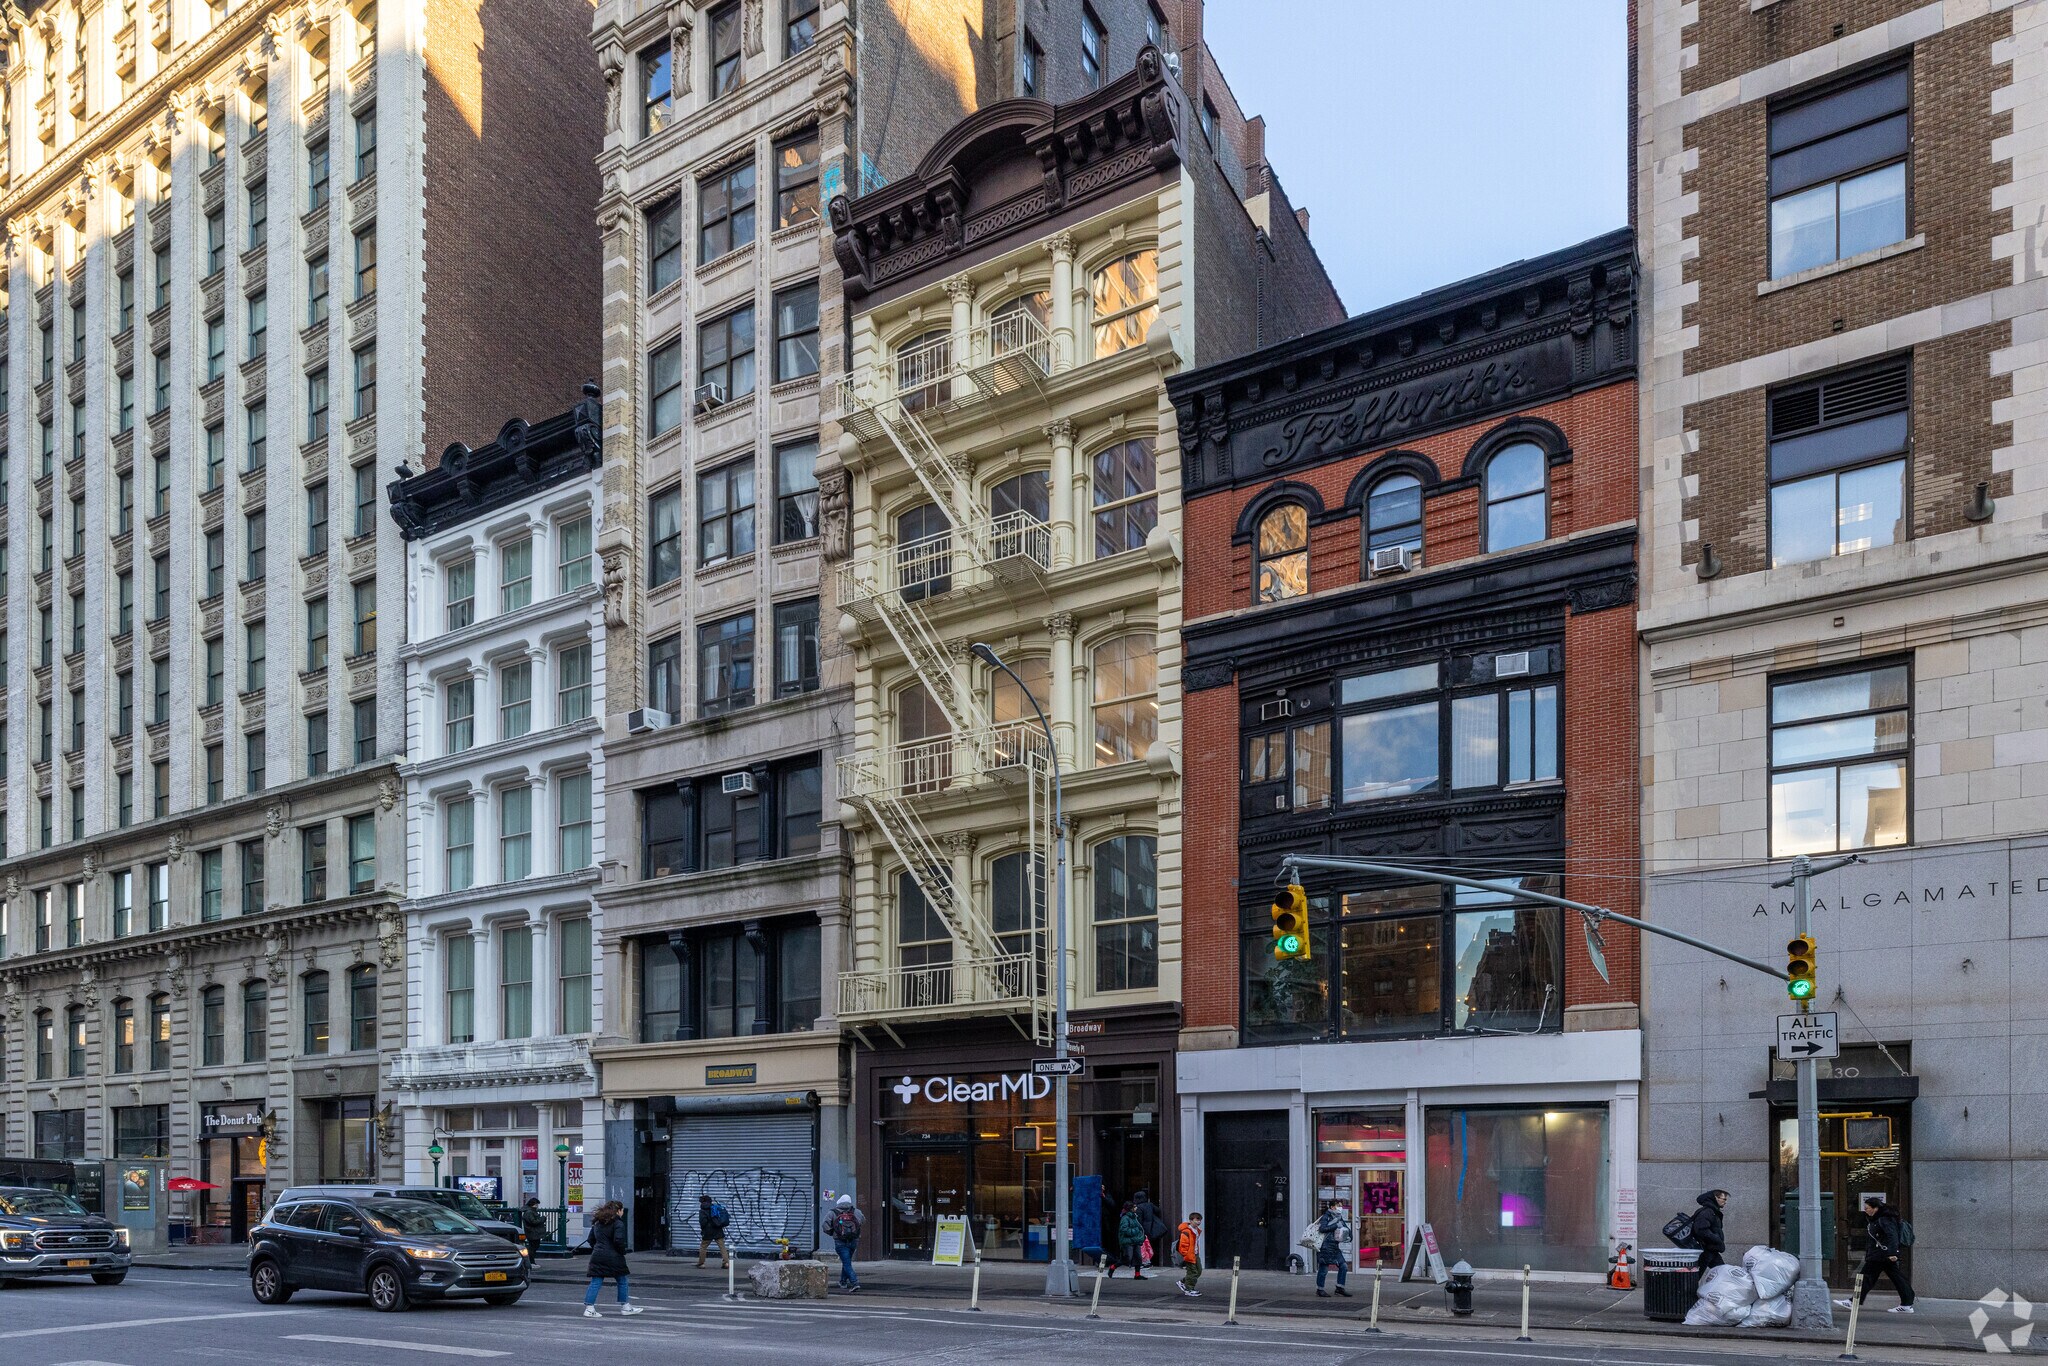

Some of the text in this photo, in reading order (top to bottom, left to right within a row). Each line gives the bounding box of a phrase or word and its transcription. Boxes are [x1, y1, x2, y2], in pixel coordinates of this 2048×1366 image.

[1752, 877, 2048, 918] AMALGAMATED
[1069, 1023, 1102, 1033] Broadway
[1791, 1016, 1823, 1029] ALL
[1781, 1029, 1834, 1041] TRAFFIC
[707, 1067, 754, 1079] BROADWAY
[1039, 1062, 1077, 1072] ONE WAY
[924, 1073, 1051, 1103] ClearMD
[204, 1112, 262, 1127] The Donut Pub
[1274, 1176, 1287, 1184] 732
